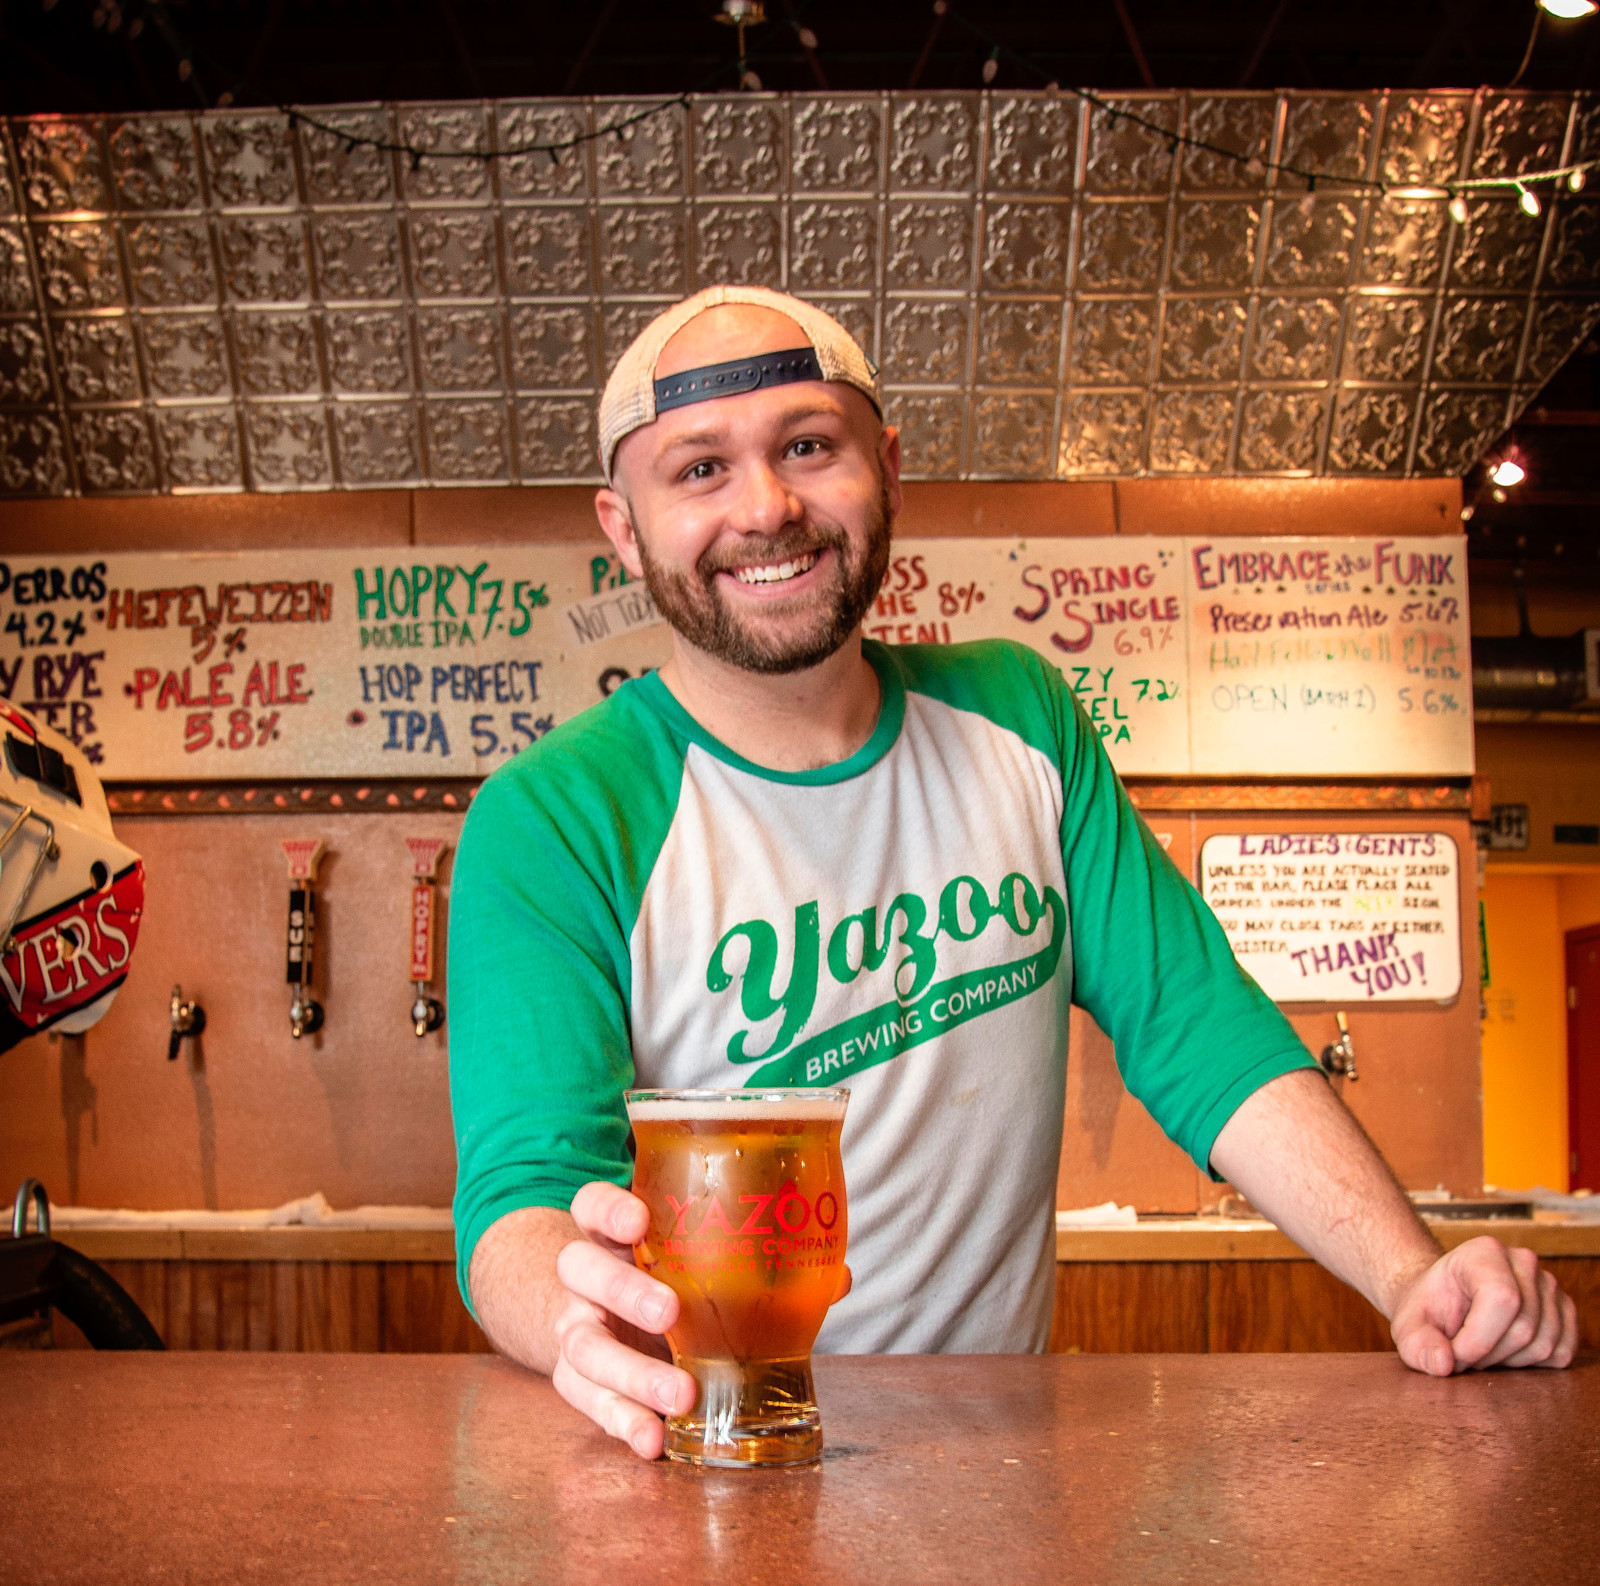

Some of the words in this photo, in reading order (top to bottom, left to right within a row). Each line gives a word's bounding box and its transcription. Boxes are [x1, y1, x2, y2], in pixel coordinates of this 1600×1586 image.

[880, 555, 929, 592] SS
[1192, 543, 1331, 590] EMBRACE
[1333, 553, 1373, 578] the
[1373, 540, 1456, 585] FUNK
[353, 561, 488, 620] HOPRY
[480, 578, 551, 640] 7.5%
[863, 592, 917, 621] HE
[937, 581, 986, 617] 8%
[1013, 562, 1156, 623] SPRING
[4, 610, 87, 649] 4.2%
[360, 624, 423, 650] DOUBLE
[431, 620, 476, 649] IPA
[1051, 596, 1181, 653] SINGLE
[1209, 603, 1342, 634] Preservation
[1346, 604, 1389, 629] Ale
[190, 623, 248, 665] 5%
[1113, 623, 1174, 657] 6.9%
[33, 651, 105, 699] RYE
[134, 662, 235, 710] PALE
[242, 660, 310, 709] ALE
[358, 662, 423, 704] HOP
[431, 660, 543, 704] PERFECT
[1080, 696, 1129, 721] EL
[1211, 683, 1288, 713] OPEN
[184, 710, 281, 754] 5.8%
[380, 709, 450, 757] IPA
[469, 711, 556, 757] 5.5%
[1238, 834, 1342, 857] LADIES
[1208, 863, 1268, 878] UNLESS
[1272, 864, 1297, 877] YOU
[1301, 864, 1327, 877] ARE
[1332, 863, 1400, 878] ACTUALLY
[1233, 880, 1256, 893] THE
[1302, 879, 1349, 892] PLEASE
[1355, 879, 1399, 892] PLACE
[1404, 879, 1433, 892] ALL
[1220, 920, 1238, 932] OU
[1244, 920, 1274, 932] MAY
[1280, 919, 1322, 932] CLOSE
[706, 872, 1066, 1065] Yazoo
[1290, 930, 1402, 978] THANK
[1350, 950, 1428, 997] YOU!
[805, 1014, 925, 1083] BREWING
[928, 960, 1040, 1024] COMPANY
[664, 1191, 838, 1236] YAZOO
[664, 1238, 756, 1257] BREWING
[761, 1234, 840, 1256] COMPANY
